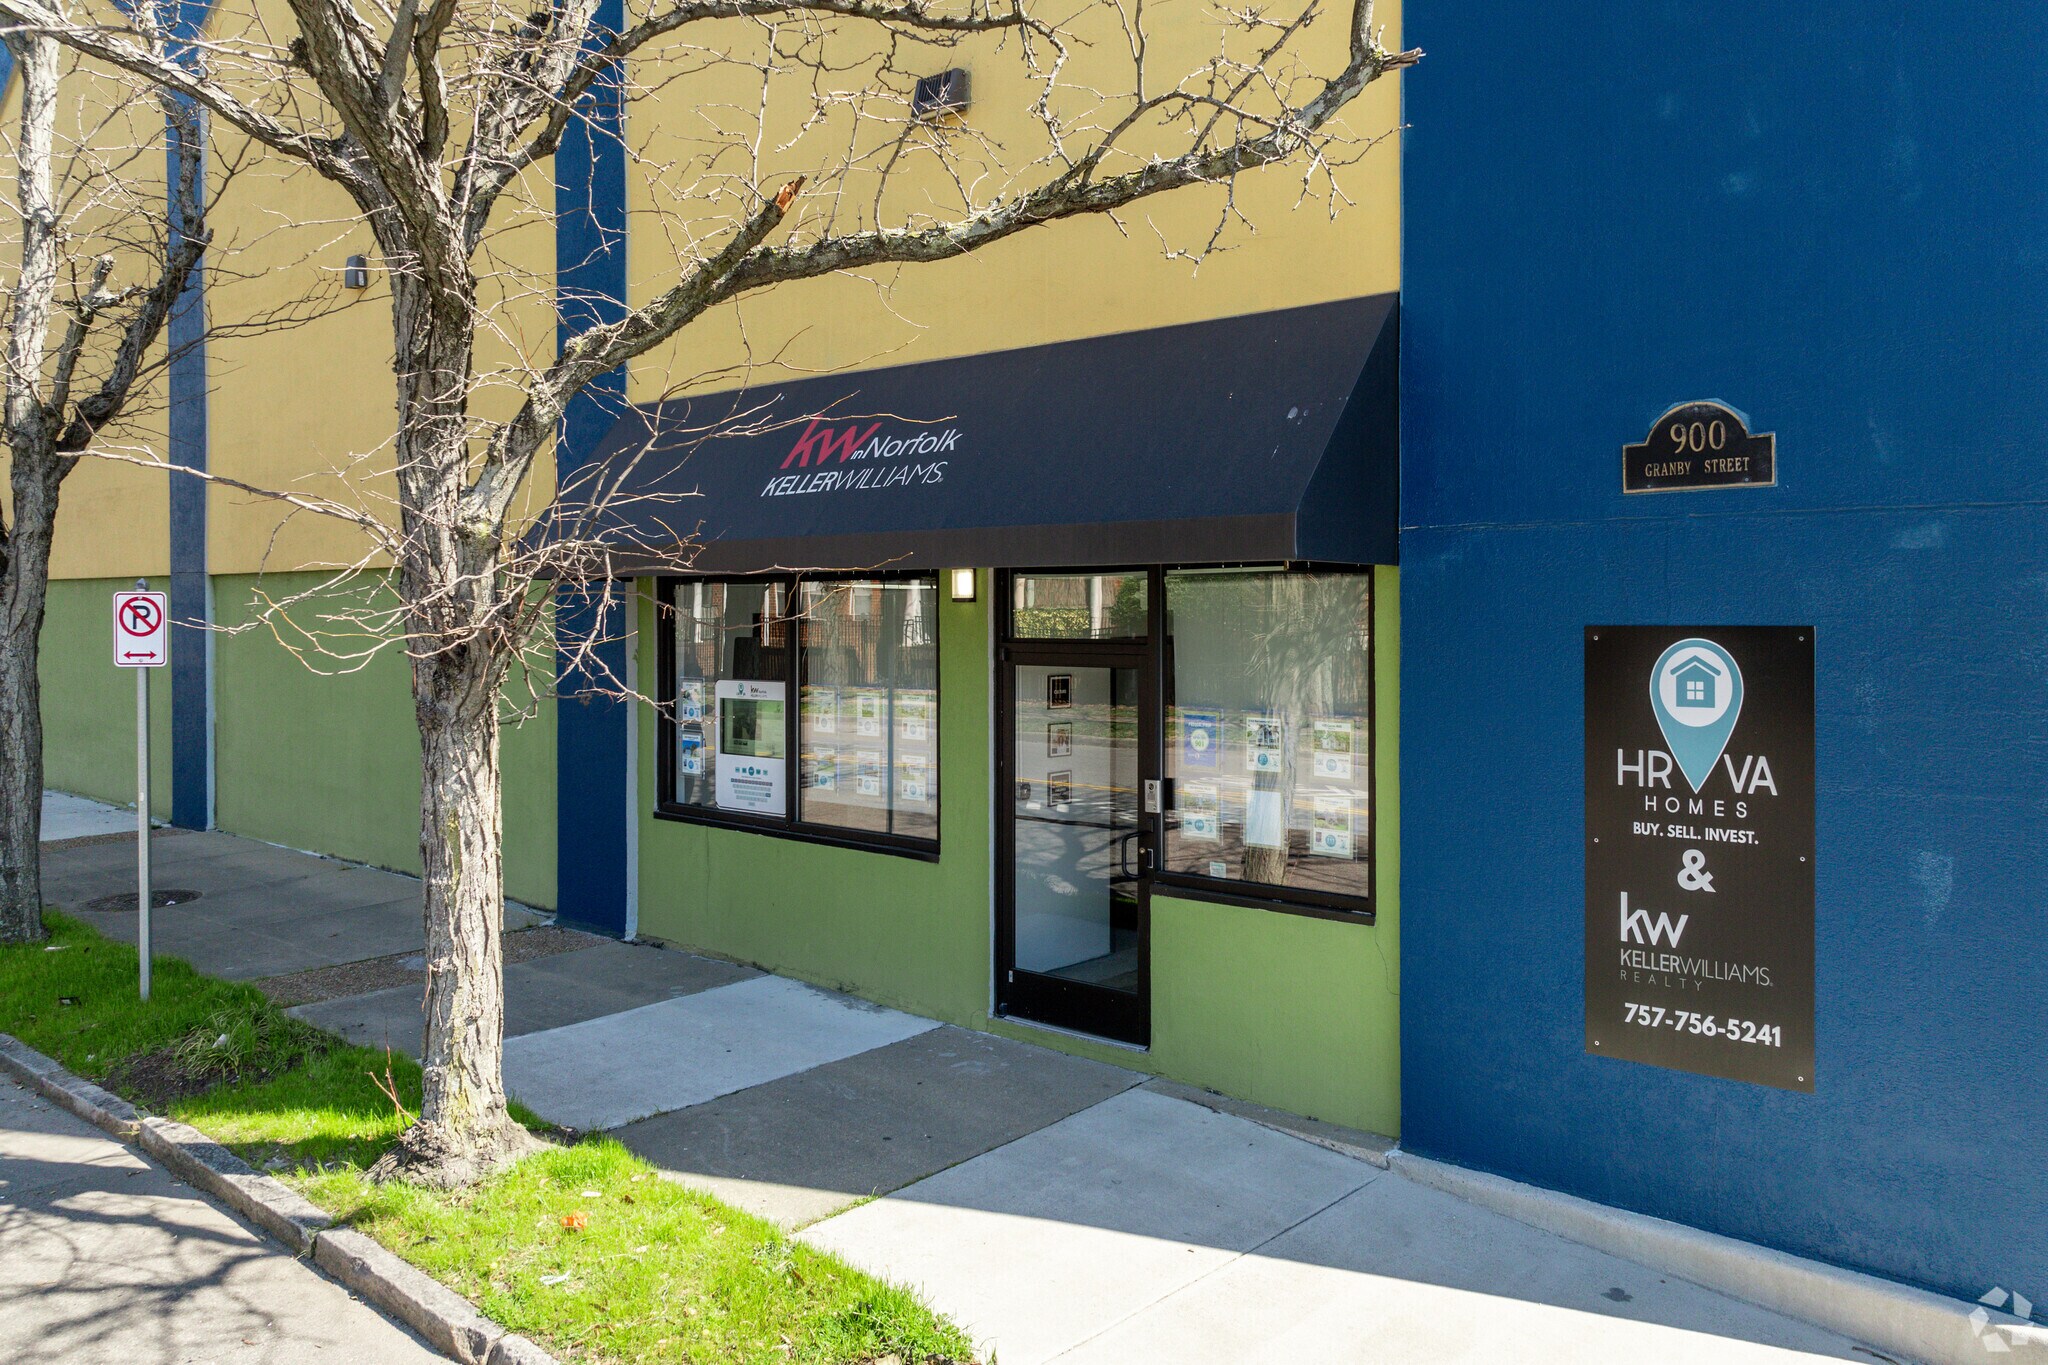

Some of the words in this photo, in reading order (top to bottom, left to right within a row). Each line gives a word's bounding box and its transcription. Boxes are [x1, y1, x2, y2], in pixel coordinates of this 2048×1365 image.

[780, 414, 883, 469] kw
[862, 428, 963, 459] Norfolk
[1669, 420, 1727, 454] 900
[1644, 461, 1692, 478] GRANBY
[1704, 456, 1750, 474] STREET
[1617, 748, 1673, 789] HR
[1723, 753, 1778, 796] VA
[1644, 795, 1748, 819] HOMES
[1633, 821, 1664, 837] BUY.
[1667, 824, 1702, 840] SELL.
[1704, 827, 1759, 845] INVEST.
[1677, 848, 1717, 893] &
[1620, 891, 1689, 949] kw
[1620, 969, 1703, 992] REALTY
[1624, 1002, 1781, 1048] 757-756-5241
